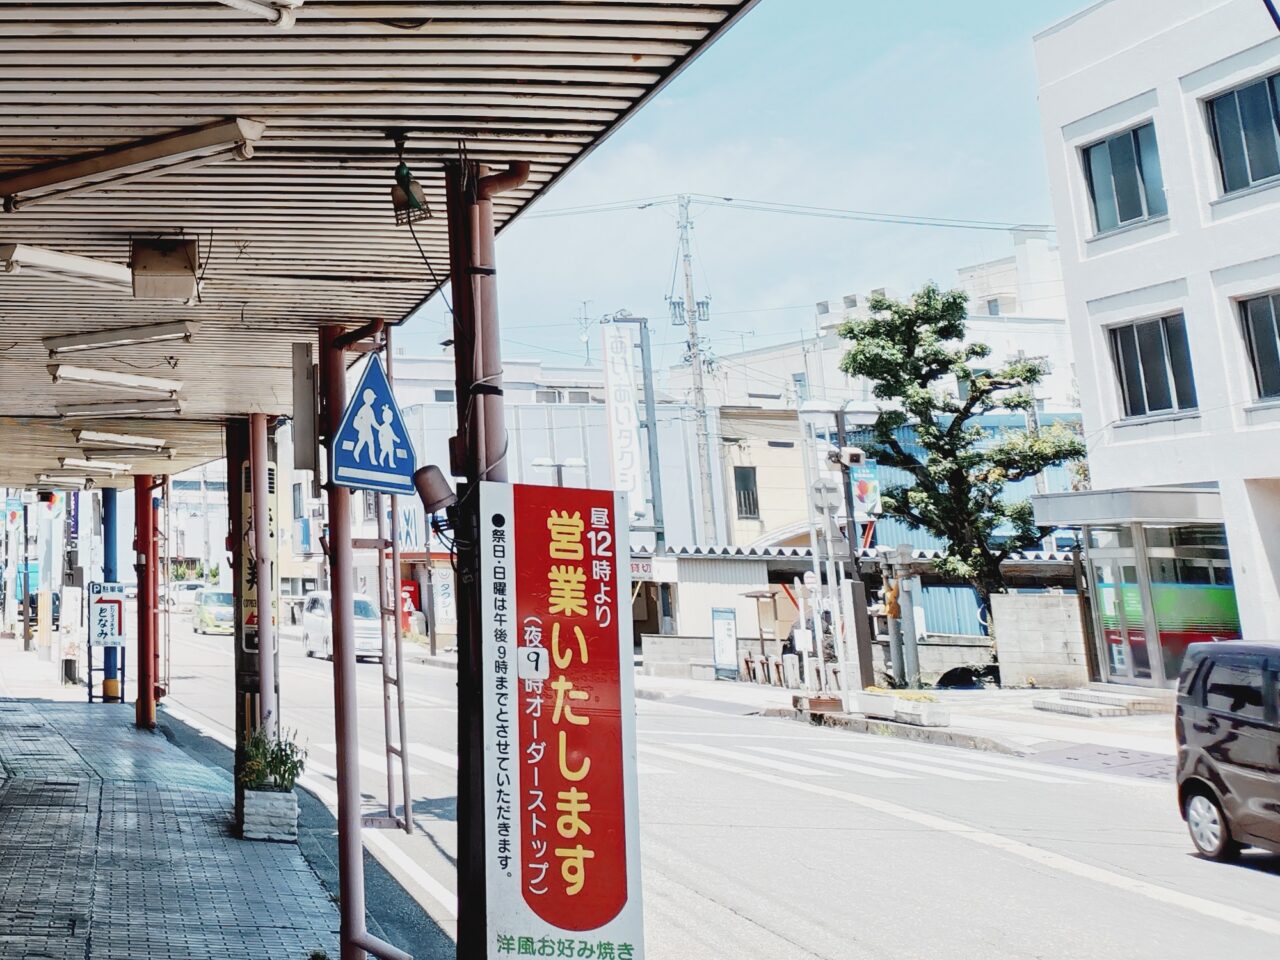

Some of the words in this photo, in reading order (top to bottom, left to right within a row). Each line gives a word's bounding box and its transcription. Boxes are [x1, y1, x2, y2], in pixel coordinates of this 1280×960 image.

[586, 507, 613, 628] 昼12時より
[97, 606, 108, 640] となみ
[547, 509, 595, 896] 営業いたします
[496, 934, 635, 960] 洋風お好み焼き
